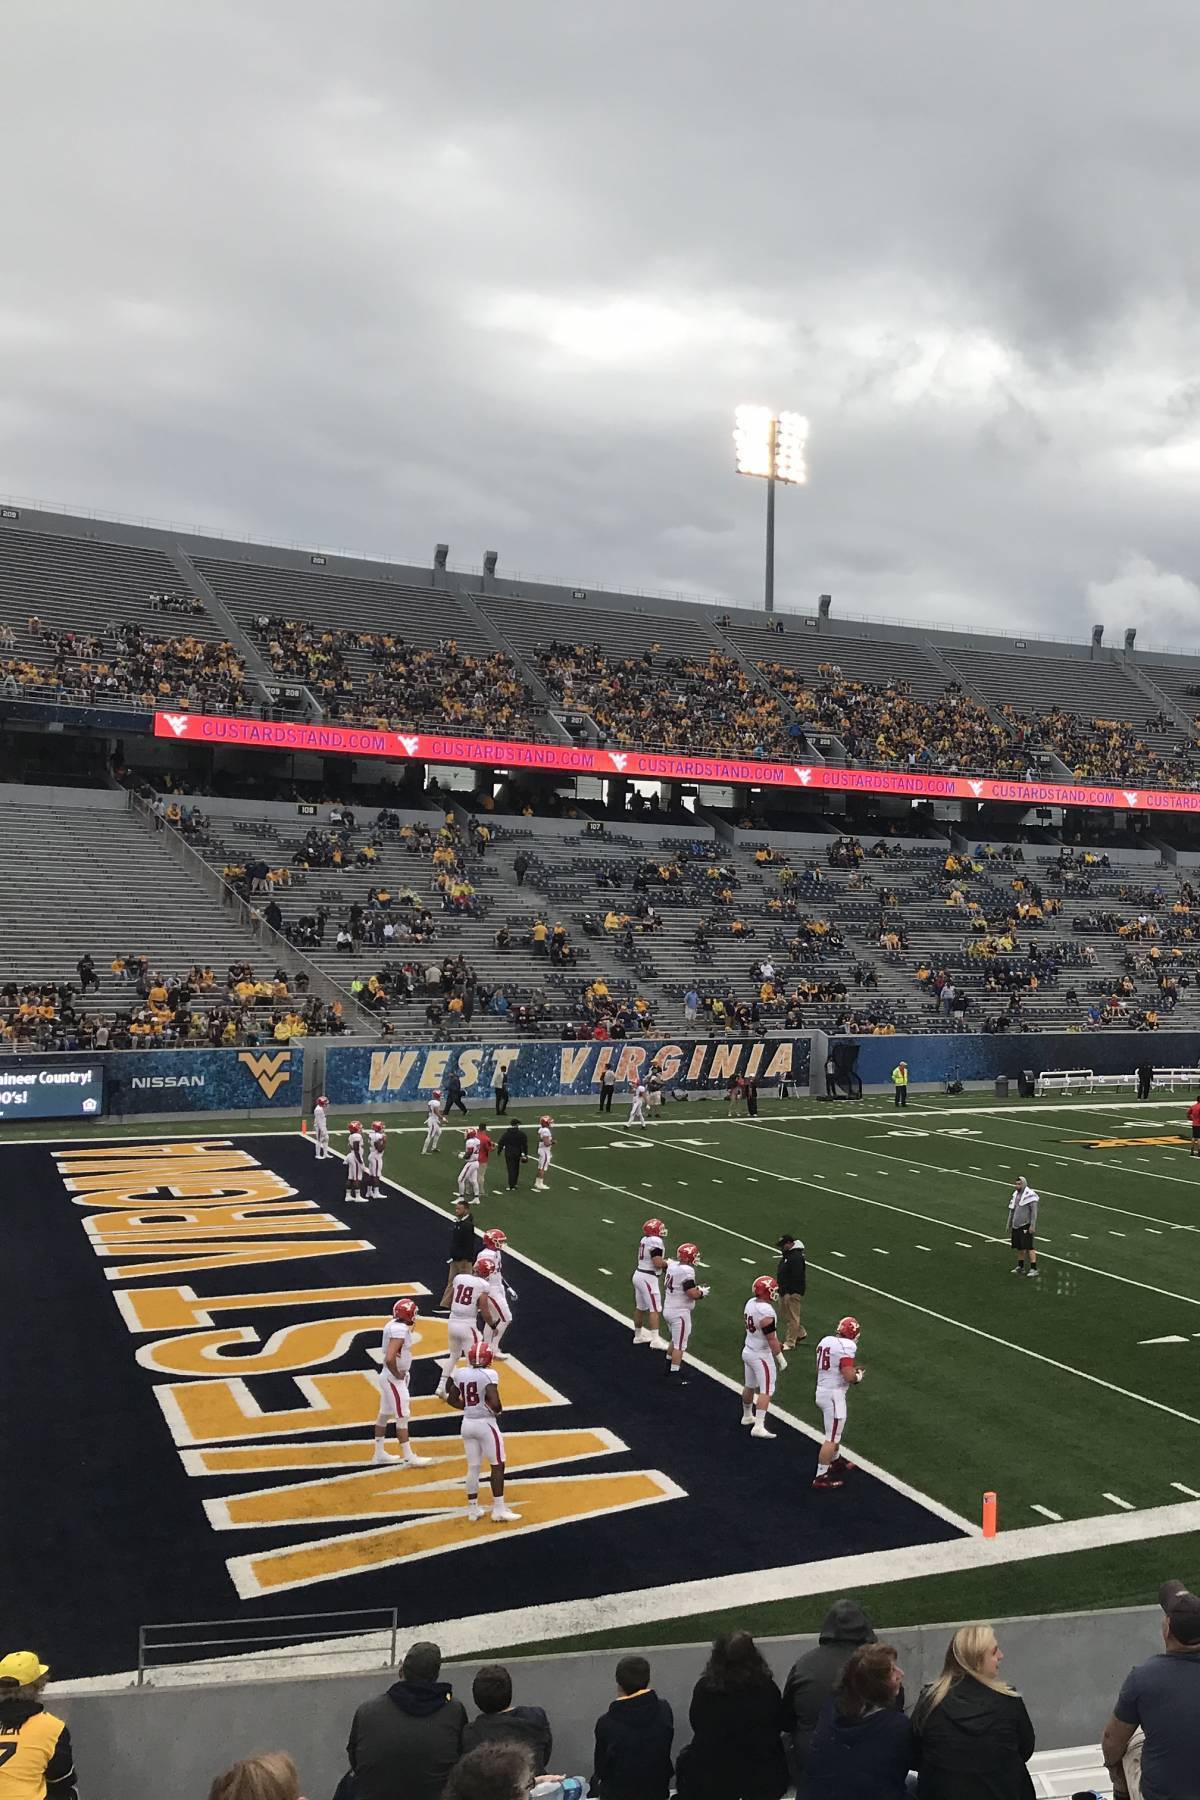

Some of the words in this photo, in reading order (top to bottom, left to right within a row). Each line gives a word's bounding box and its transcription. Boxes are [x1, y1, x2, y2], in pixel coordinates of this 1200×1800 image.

[201, 721, 386, 751] CUSTARDSTAND.COM
[431, 740, 594, 767] CUSTARDSTAND.COM
[638, 759, 785, 783] CUSTARDSTAND.COM
[822, 771, 955, 793] CUSTARDSTAND.COM
[992, 784, 1115, 804] CUSTARDSTAND.COM
[39, 1069, 92, 1086] Country!
[369, 1048, 520, 1091] WEST
[559, 1043, 793, 1084] VIRGINIA
[131, 1075, 205, 1089] NISSAN
[50, 1140, 377, 1281] VIRGINIA
[455, 1284, 474, 1305] 18
[459, 1381, 480, 1407] 18
[113, 1281, 689, 1600] WEST
